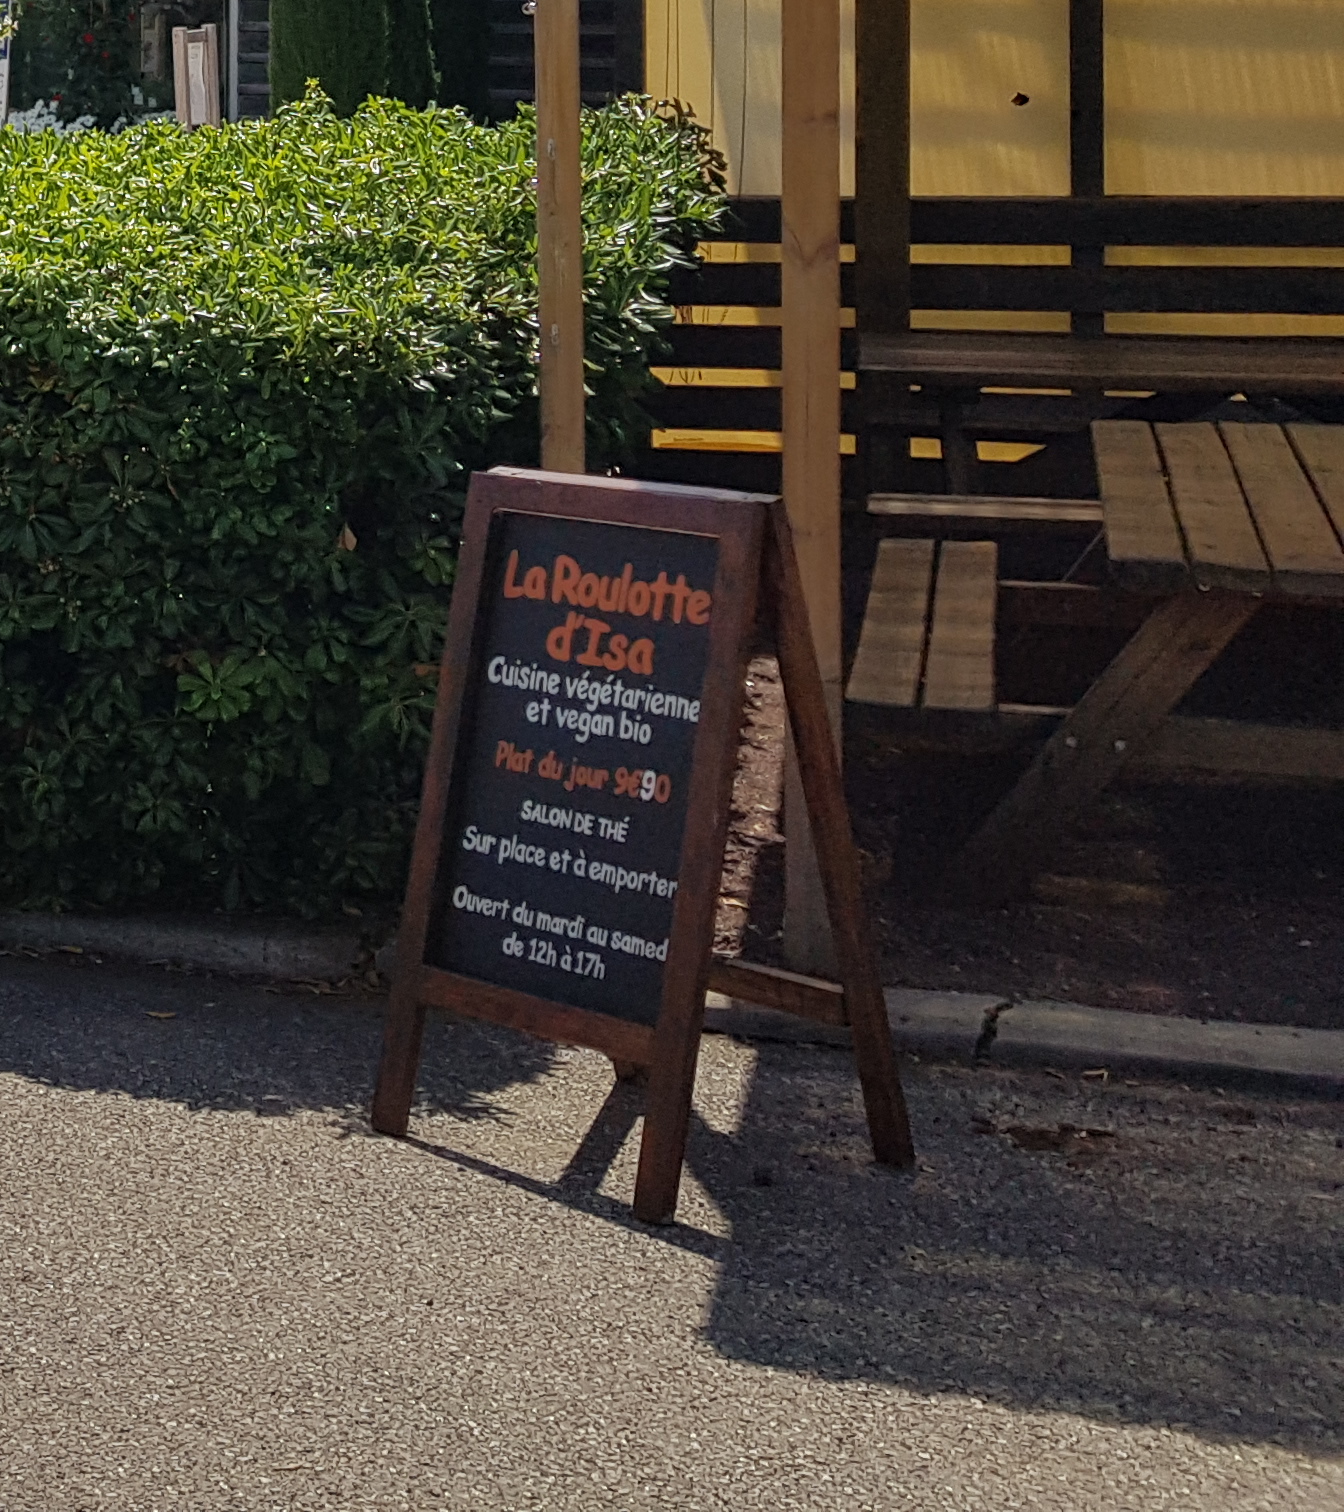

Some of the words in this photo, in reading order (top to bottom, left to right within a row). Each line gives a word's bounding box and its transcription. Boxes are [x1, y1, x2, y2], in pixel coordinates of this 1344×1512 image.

[503, 549, 547, 600] La
[551, 554, 711, 625] Roulotte
[546, 610, 655, 675] d'Isa
[487, 656, 560, 694] Cuisine
[565, 670, 701, 723] végétarienne
[526, 698, 551, 725] et
[556, 706, 613, 743] vegan
[619, 711, 652, 744] bio
[494, 740, 534, 773] Plat
[538, 750, 562, 780] du
[563, 758, 609, 792] jour
[520, 800, 572, 829] SALON
[573, 813, 595, 835] DE
[598, 816, 630, 842] THÉ
[462, 826, 497, 855] Sur
[498, 835, 545, 864] place
[549, 848, 572, 874] et
[574, 849, 587, 878] à
[589, 861, 678, 899] emporter
[452, 885, 510, 919] Ouvert
[512, 901, 535, 927] du
[536, 911, 585, 938] mardi
[587, 926, 608, 947] au
[502, 932, 524, 957] de
[528, 938, 557, 967] 12h
[560, 945, 572, 972] à
[575, 950, 605, 980] 17h
